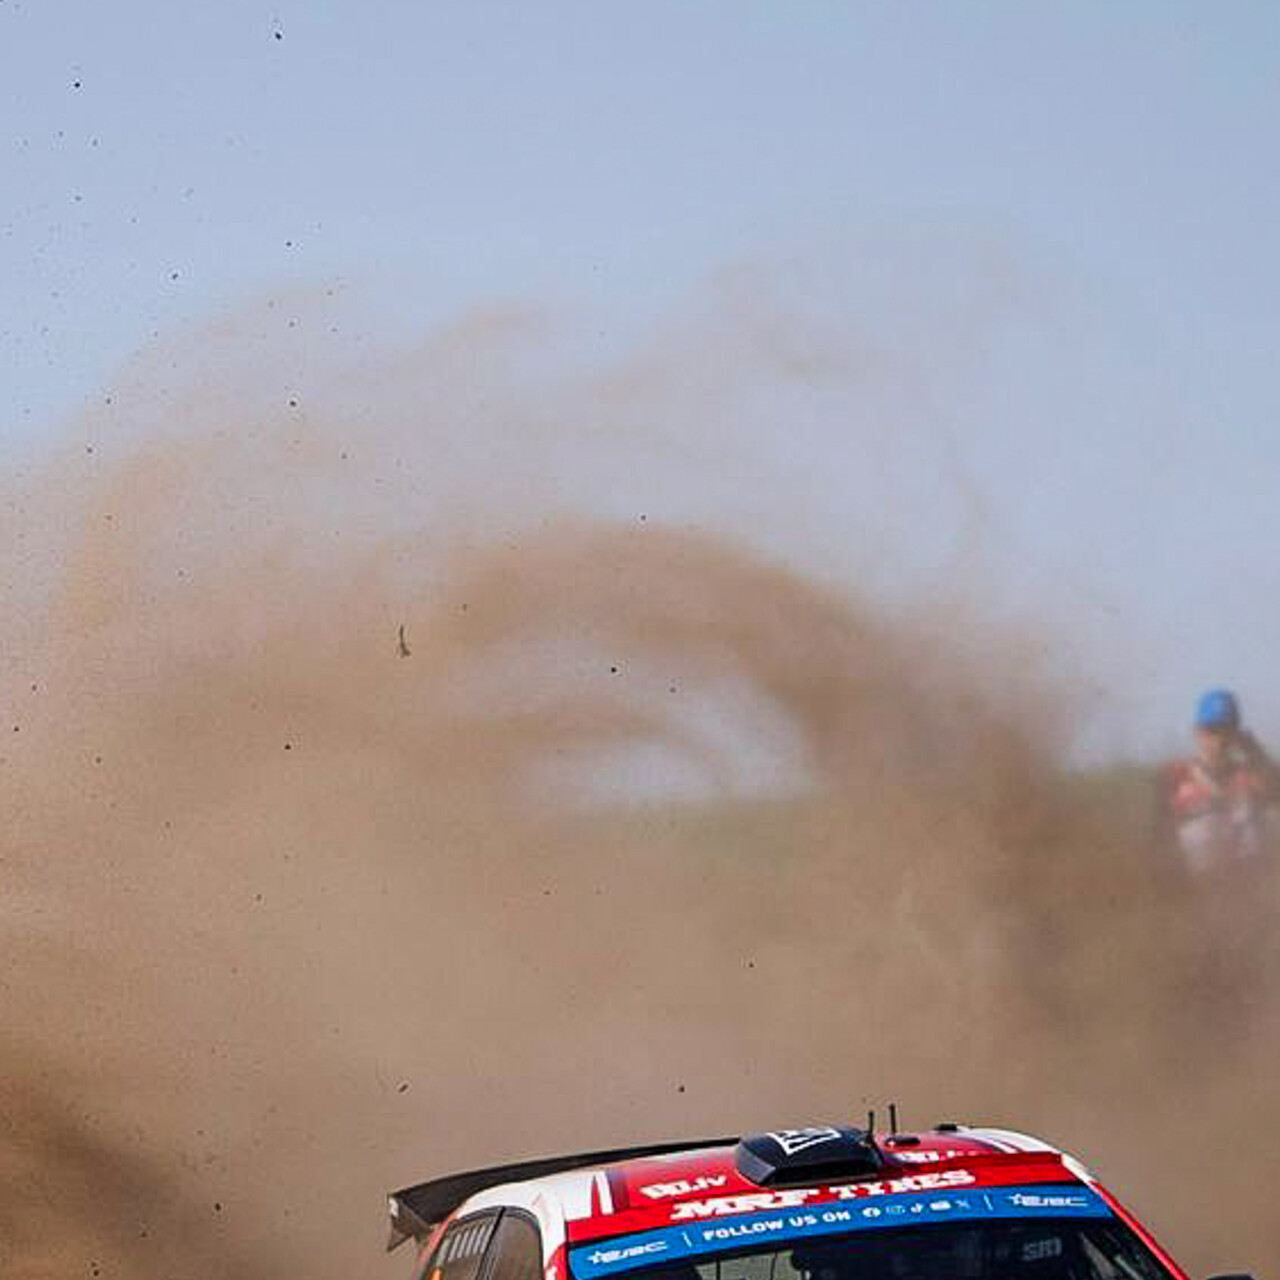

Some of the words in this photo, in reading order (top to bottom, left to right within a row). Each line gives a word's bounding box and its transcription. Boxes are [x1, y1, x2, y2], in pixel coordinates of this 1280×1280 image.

[670, 1188, 819, 1221] MRF
[702, 1217, 784, 1241] FOLLOW
[788, 1211, 818, 1228] US
[822, 1209, 852, 1223] ON
